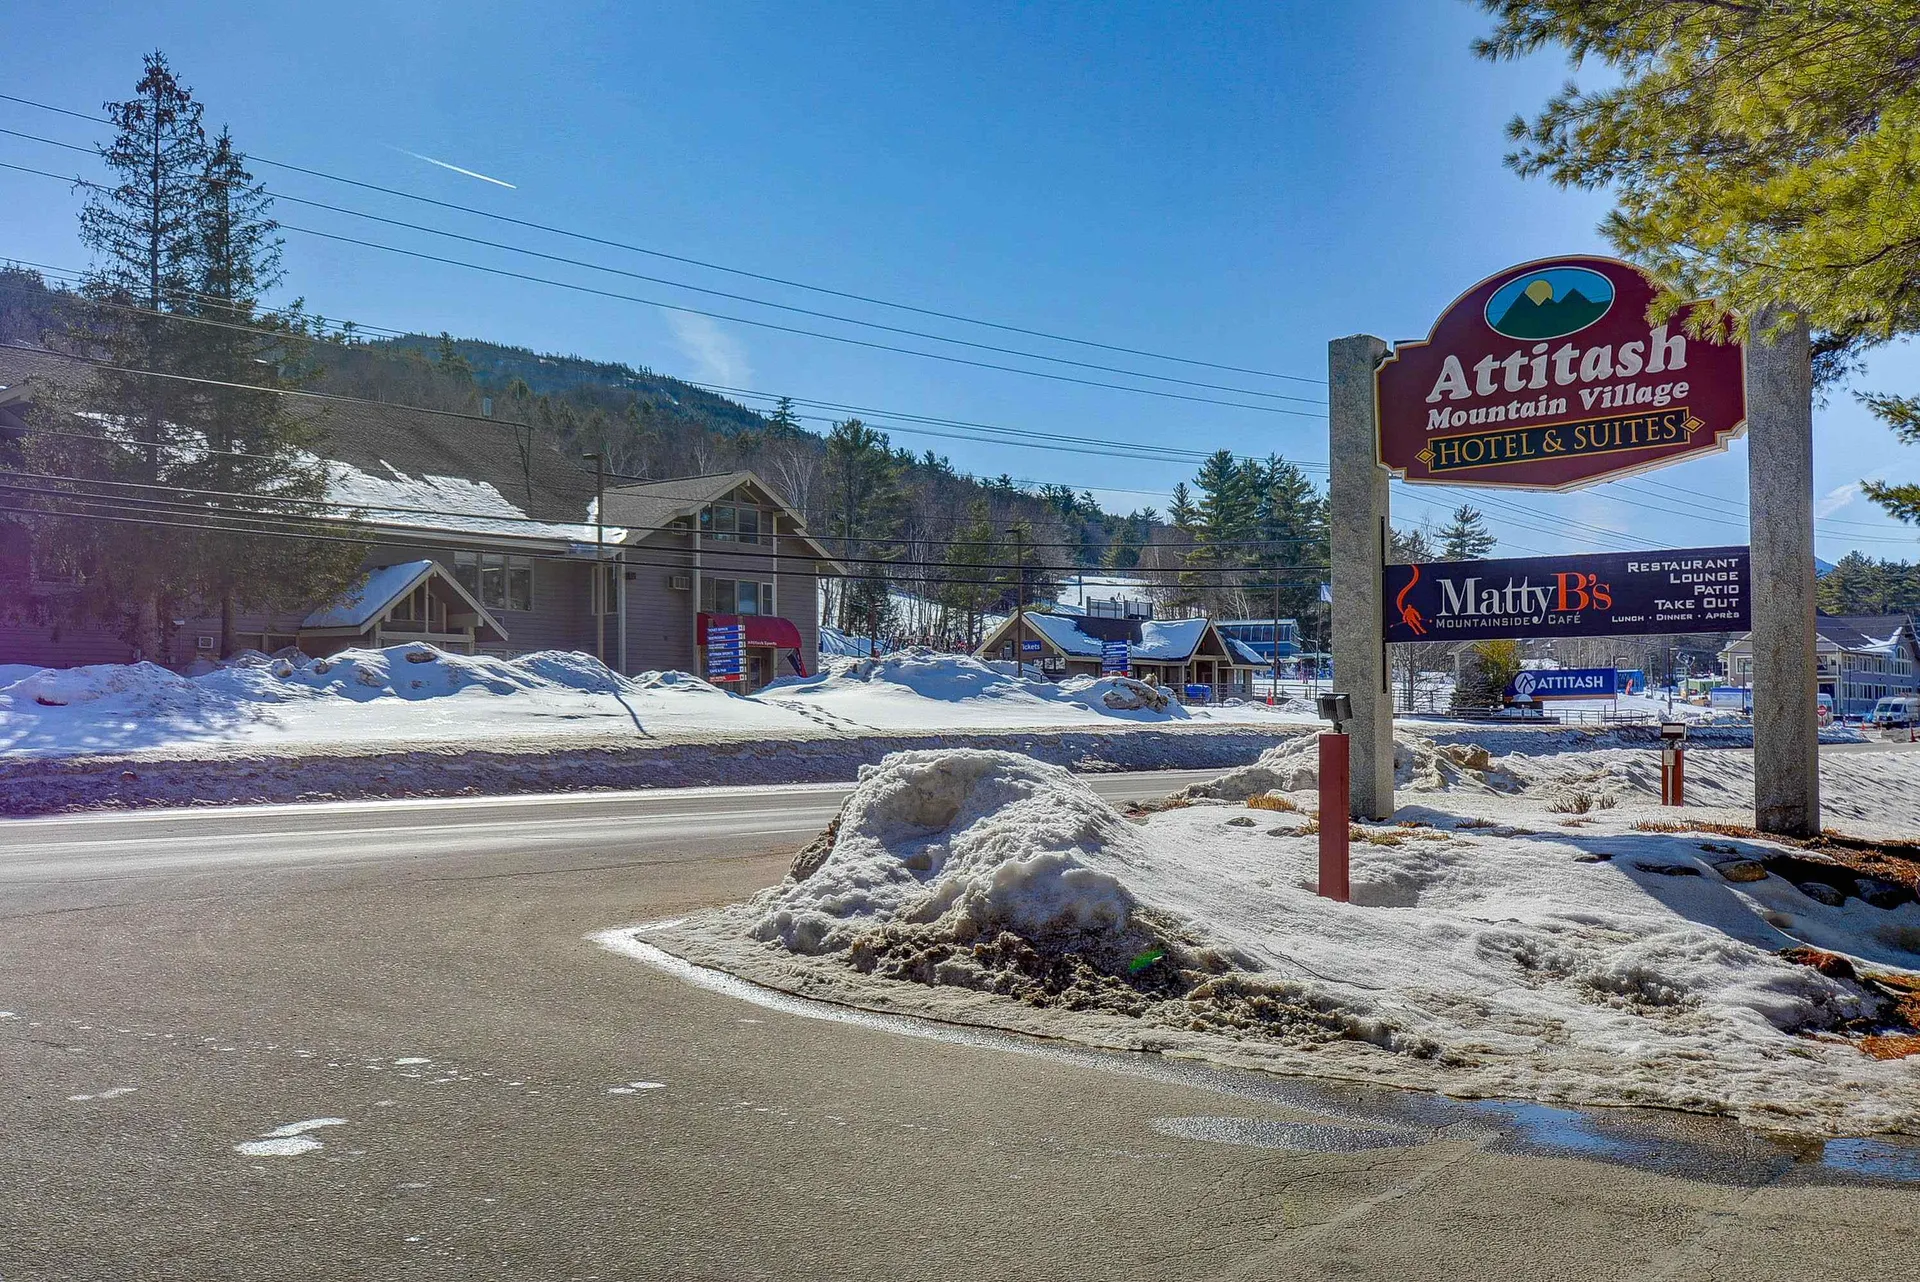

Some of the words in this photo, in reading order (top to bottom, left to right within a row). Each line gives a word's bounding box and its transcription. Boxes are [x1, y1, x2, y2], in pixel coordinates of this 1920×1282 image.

[1426, 326, 1687, 402] Attitash
[1426, 395, 1567, 430] Mountain
[1579, 382, 1689, 410] Village
[1439, 433, 1535, 465] HOTEL
[1542, 429, 1567, 453] &
[1574, 415, 1677, 449] SUITES
[1537, 675, 1604, 689] ATTITASH
